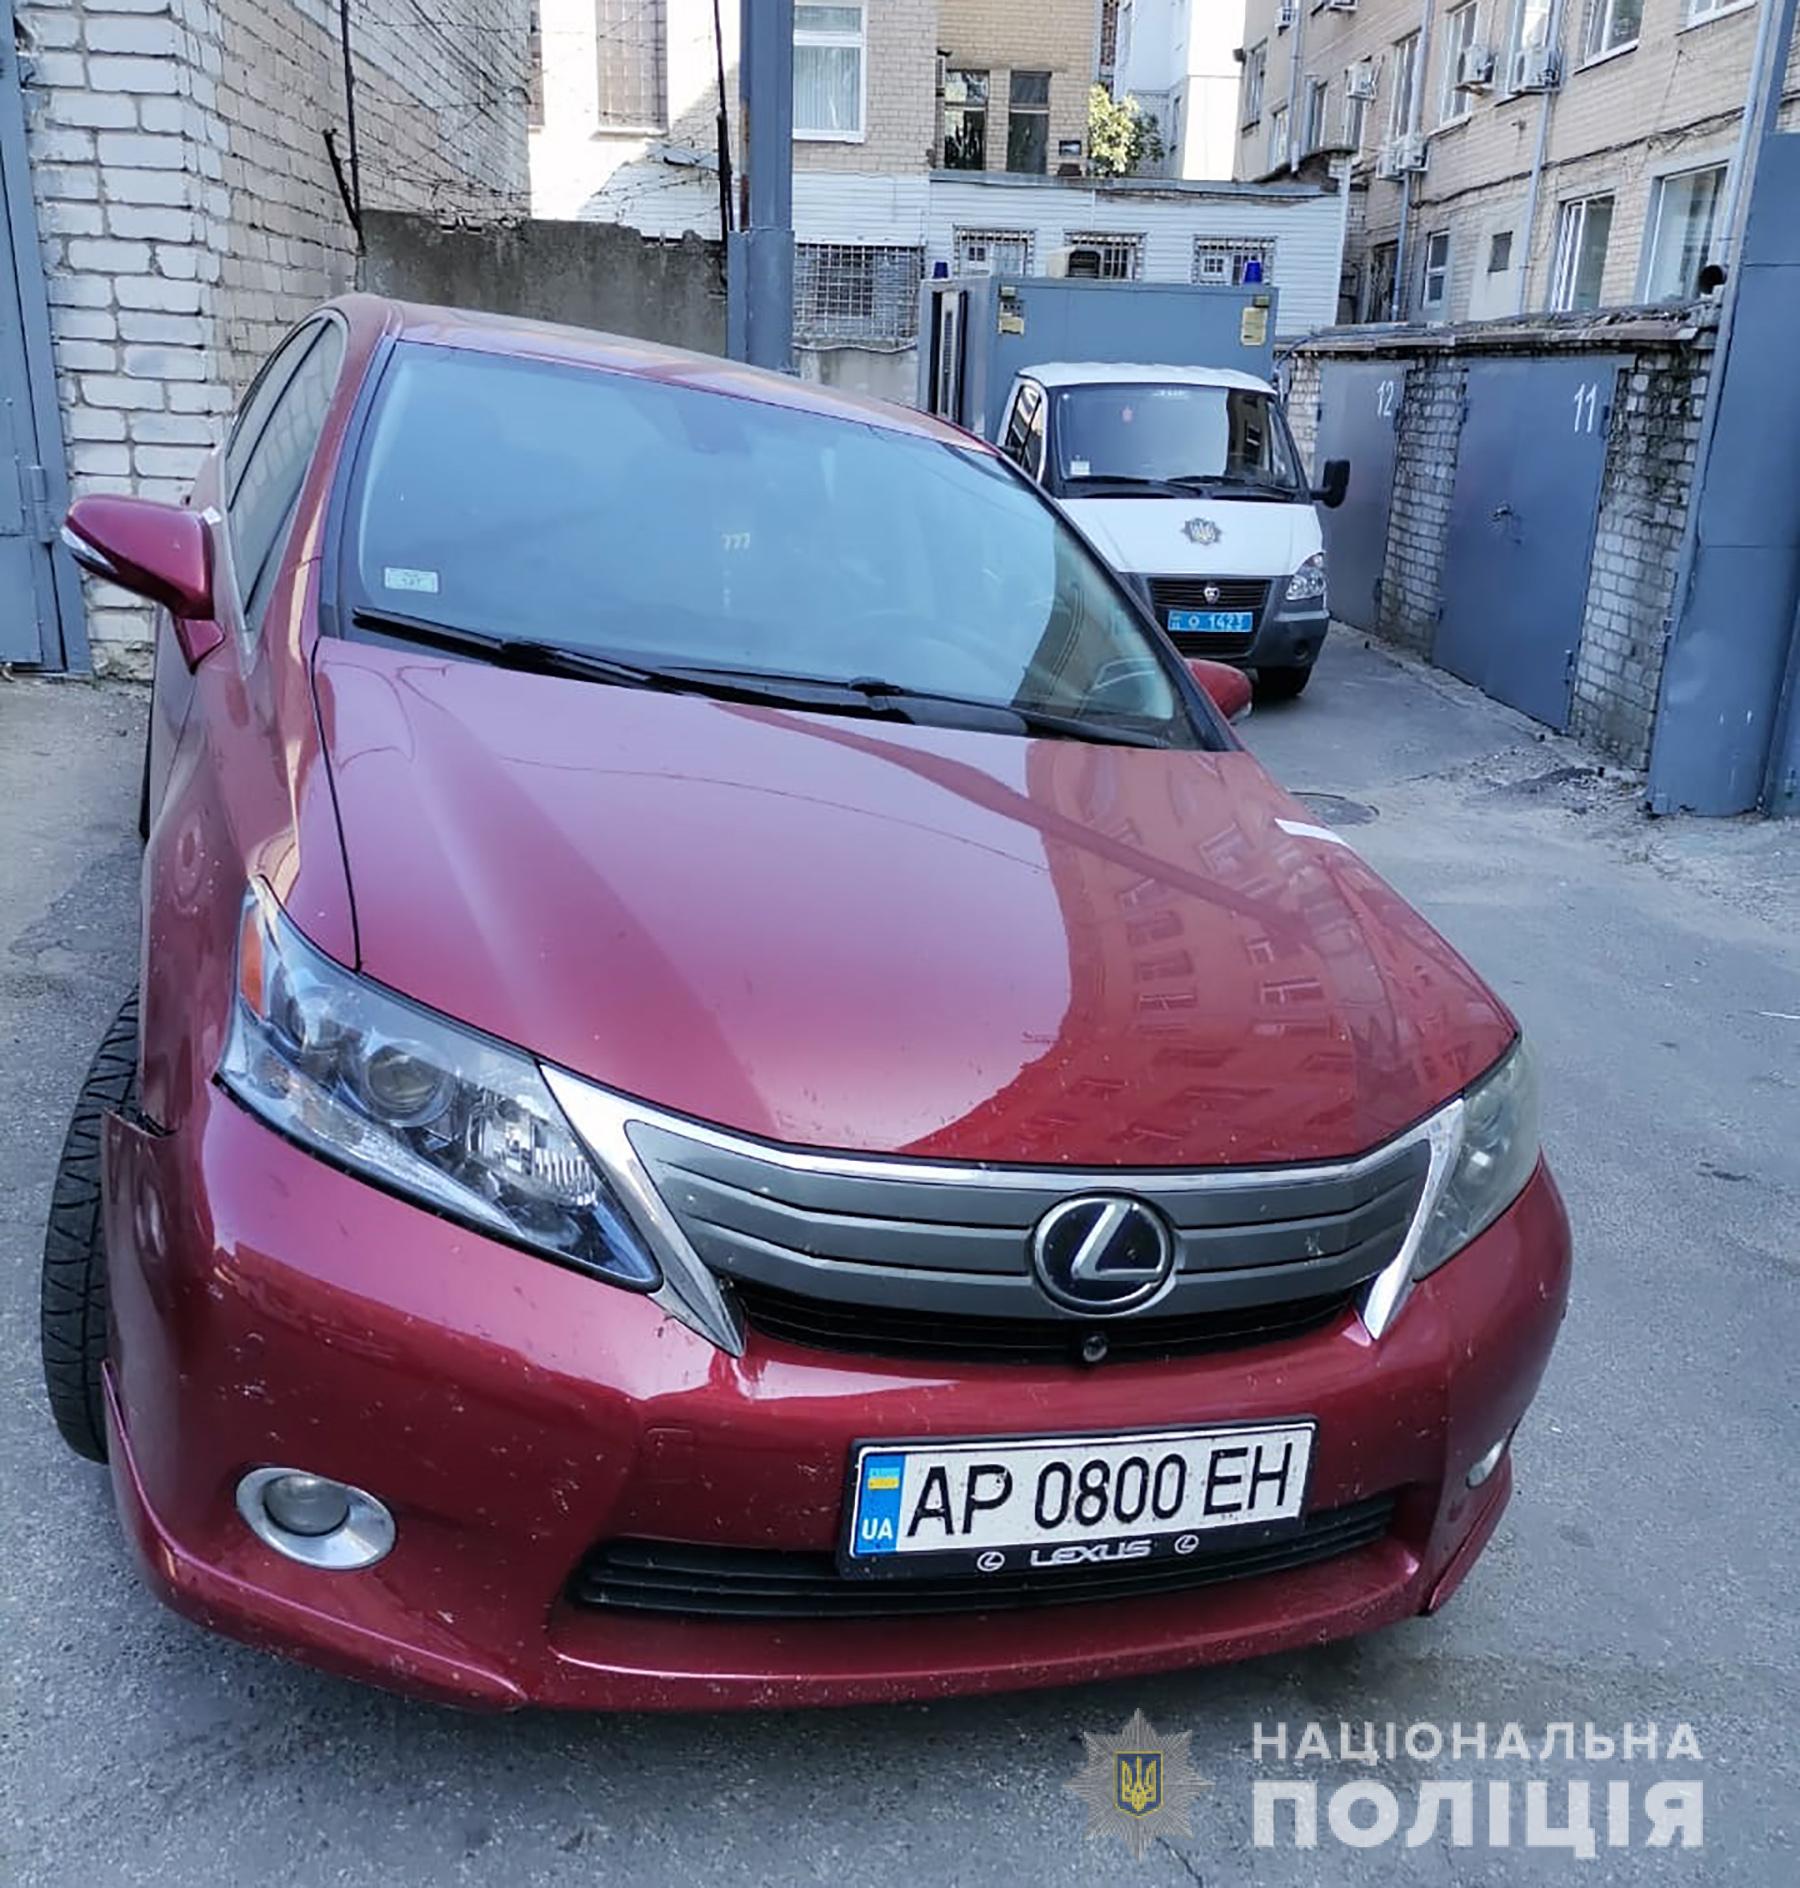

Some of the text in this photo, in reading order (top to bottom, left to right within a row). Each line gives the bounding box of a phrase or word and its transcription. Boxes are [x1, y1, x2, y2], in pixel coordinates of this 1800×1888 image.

[1376, 380, 1395, 418] 12
[1574, 383, 1598, 433] 11
[907, 1442, 1294, 1537] AP 0800 EH
[862, 1518, 893, 1541] UA
[1030, 1540, 1153, 1567] LEXUS
